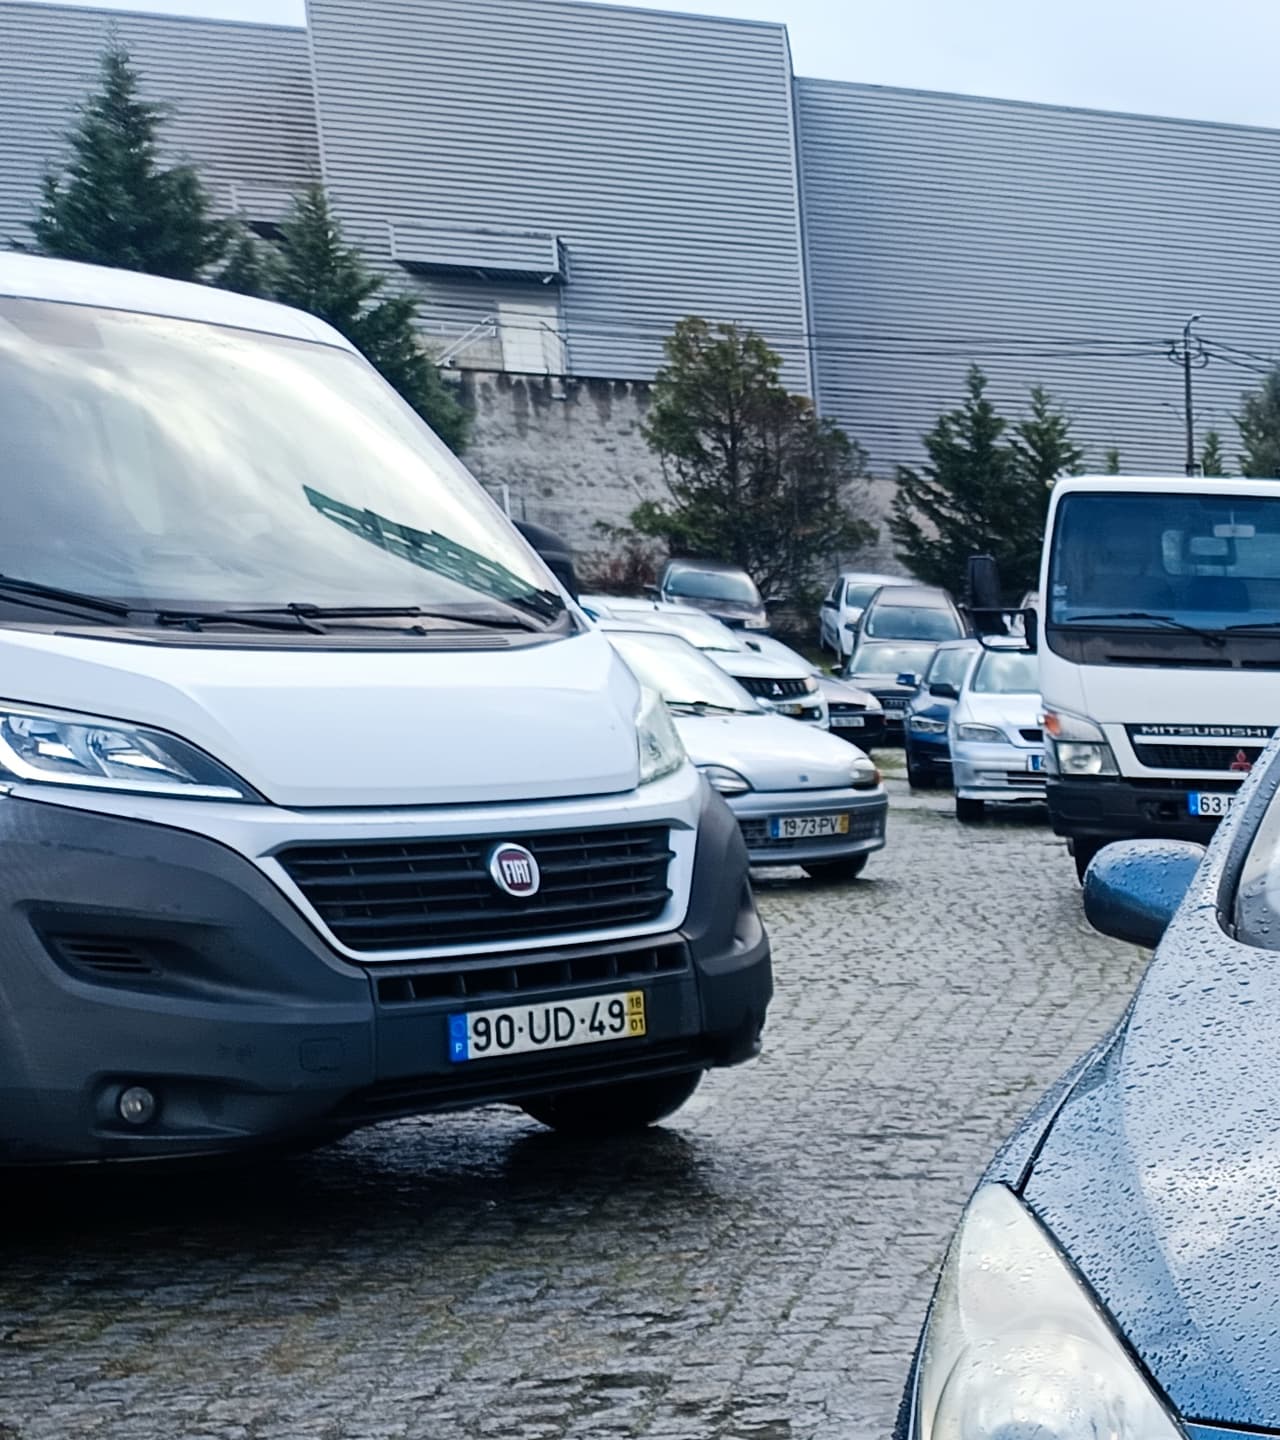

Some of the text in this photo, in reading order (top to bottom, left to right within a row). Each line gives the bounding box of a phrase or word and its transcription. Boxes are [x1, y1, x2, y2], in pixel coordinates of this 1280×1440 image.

[1141, 726, 1267, 736] MITSUBISHI
[502, 860, 530, 884] FIAT
[631, 1018, 643, 1030] 01
[456, 1043, 462, 1053] P
